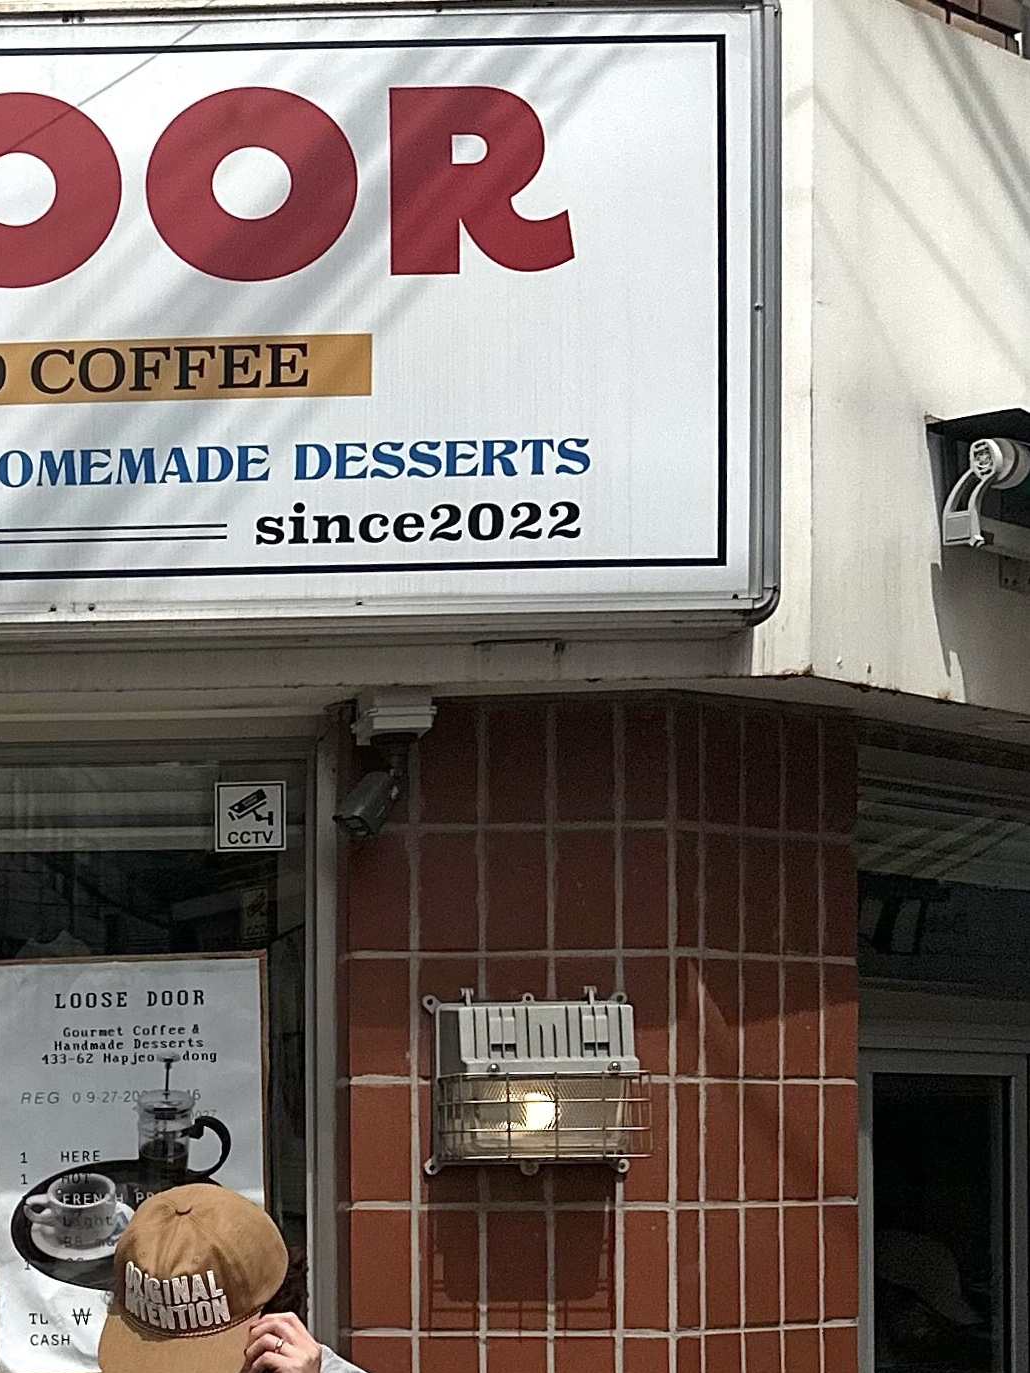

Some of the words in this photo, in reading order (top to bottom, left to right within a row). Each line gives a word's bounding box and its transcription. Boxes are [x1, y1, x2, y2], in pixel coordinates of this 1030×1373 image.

[31, 343, 308, 394] COFFEE
[294, 438, 590, 480] DESSERTS
[256, 502, 580, 545] since2022
[227, 830, 274, 844] CCTV
[55, 992, 127, 1008] LOOSE
[147, 990, 204, 1006] DOOR
[63, 1027, 123, 1038] Gourmet
[133, 1025, 185, 1036] Coffee
[192, 1024, 200, 1035] &
[54, 1041, 124, 1051] Handmade
[134, 1038, 204, 1049] Desserts
[41, 1053, 94, 1065] 433-62
[21, 1091, 60, 1104] REG
[20, 1152, 28, 1164] 1
[60, 1150, 101, 1163] HERE
[20, 1173, 28, 1185] 1
[62, 1193, 124, 1206] FRENCH
[29, 1313, 49, 1326] TL
[30, 1334, 71, 1346] CASH
